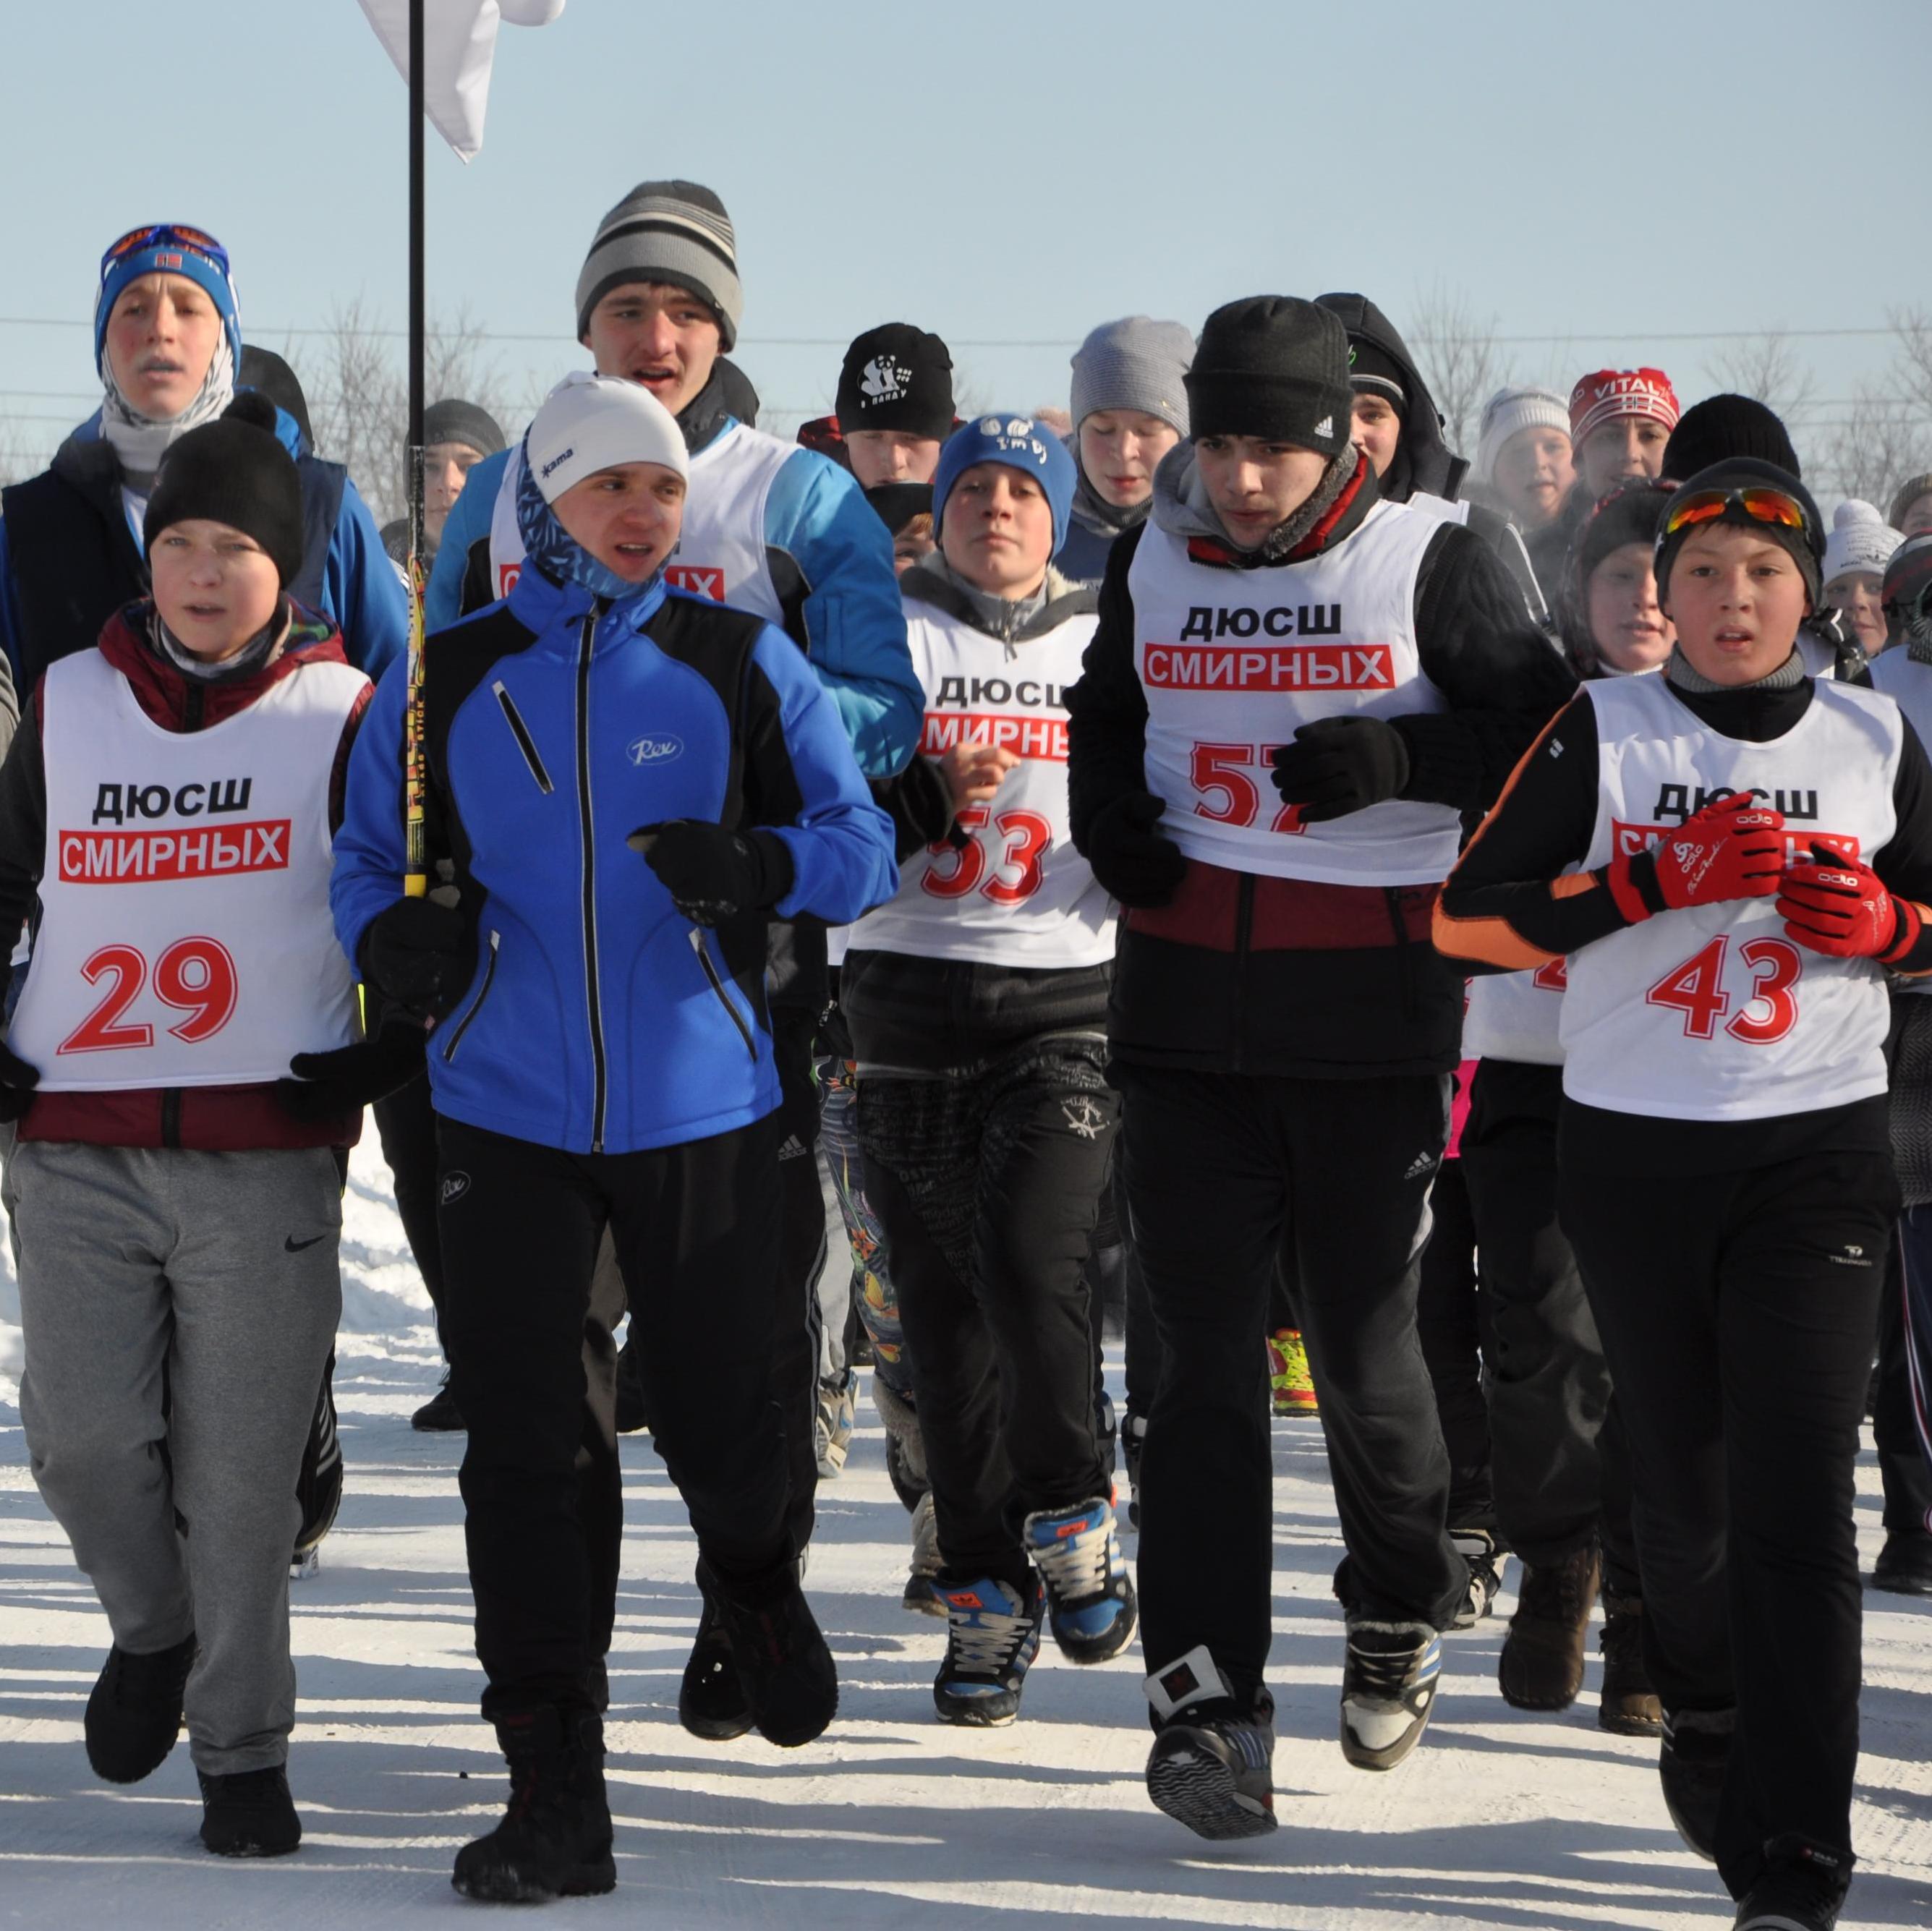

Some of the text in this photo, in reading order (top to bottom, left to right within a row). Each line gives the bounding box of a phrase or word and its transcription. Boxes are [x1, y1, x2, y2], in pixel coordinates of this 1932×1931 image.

[1180, 604, 1341, 642] ДЮСШ
[1147, 649, 1389, 685] СМИРНЫХ
[631, 739, 677, 764] Rex
[93, 777, 252, 826] ДЮСШ
[1736, 813, 1773, 824] odlo
[62, 825, 285, 878] СМИРНЫХ
[921, 807, 1052, 905] 53
[1681, 845, 1703, 874] odlo
[1818, 873, 1858, 887] odlo
[56, 935, 239, 1055] 29
[1646, 934, 1802, 1045] 43
